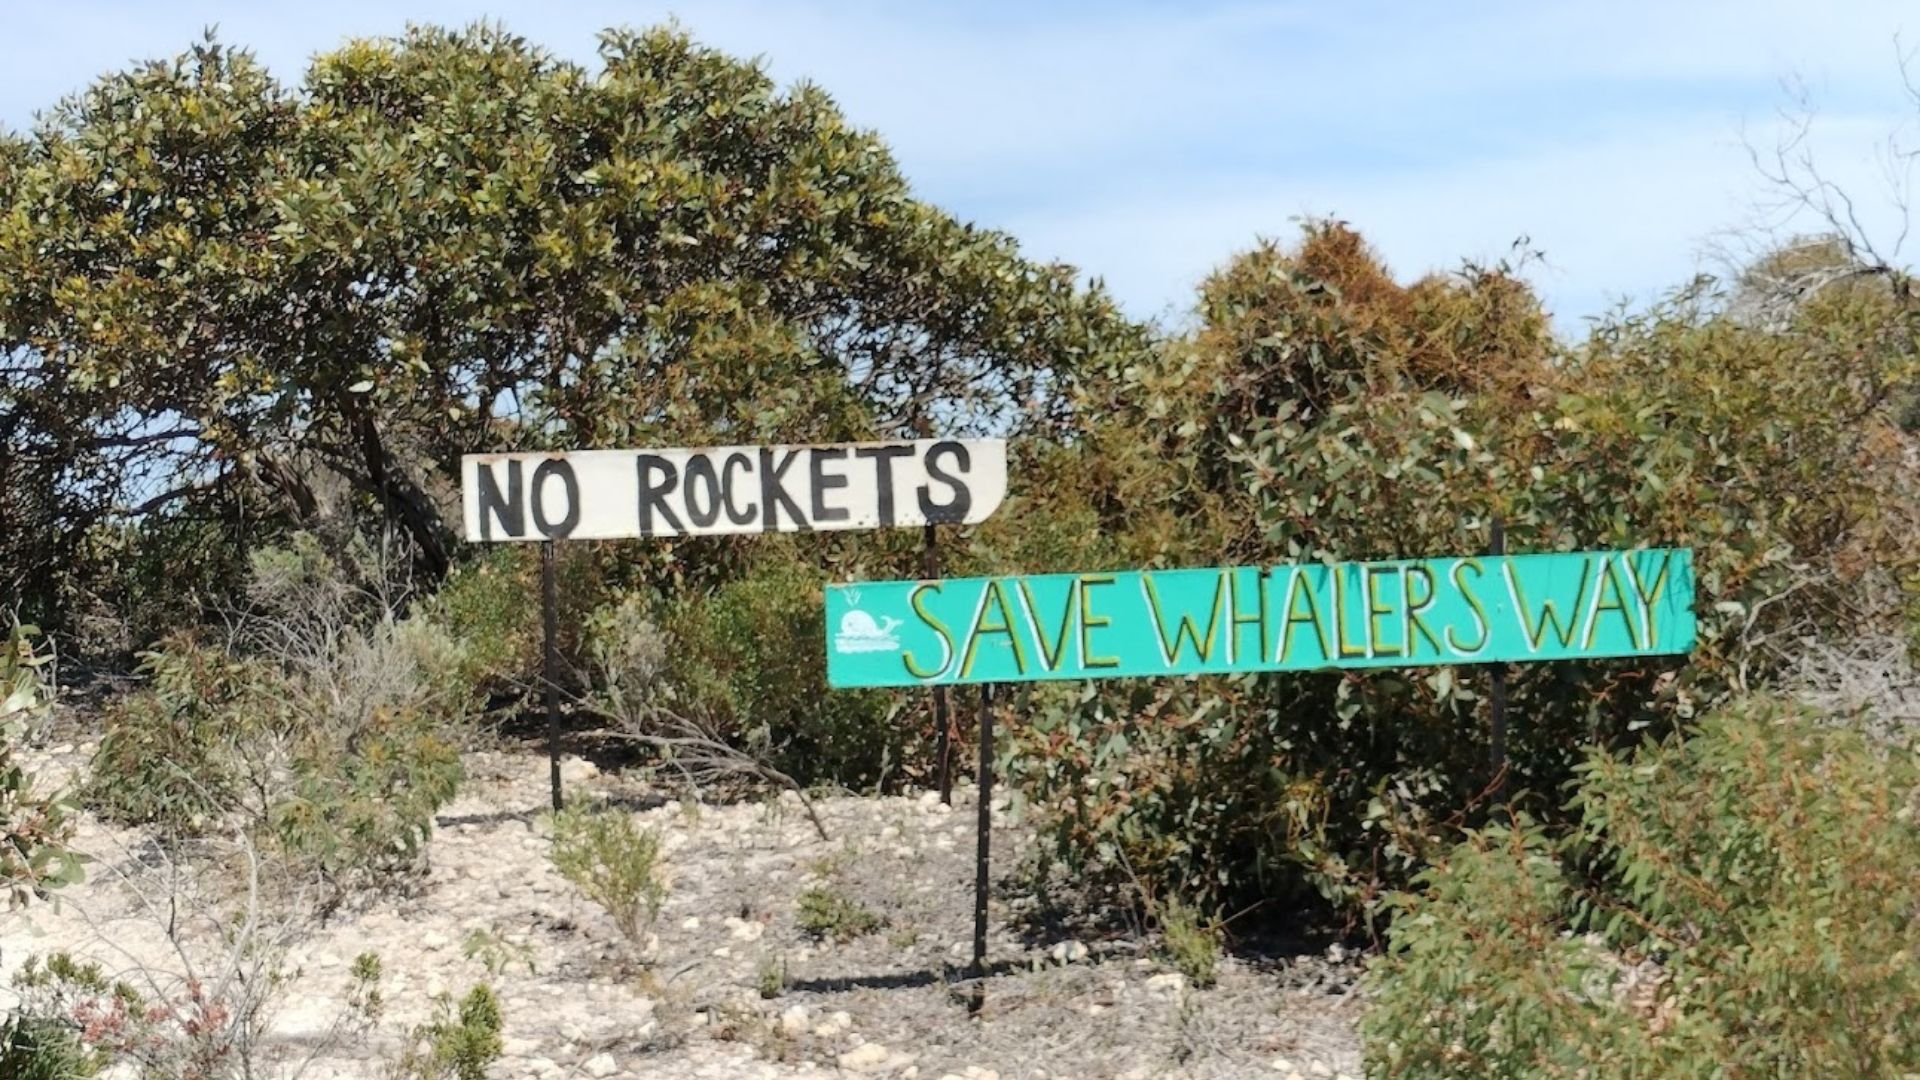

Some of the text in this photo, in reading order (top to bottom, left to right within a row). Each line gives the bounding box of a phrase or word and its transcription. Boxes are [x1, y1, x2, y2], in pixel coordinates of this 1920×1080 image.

[477, 441, 972, 541] NO ROCKETS
[902, 574, 1121, 682] SAVE
[1502, 549, 1673, 653] WAY
